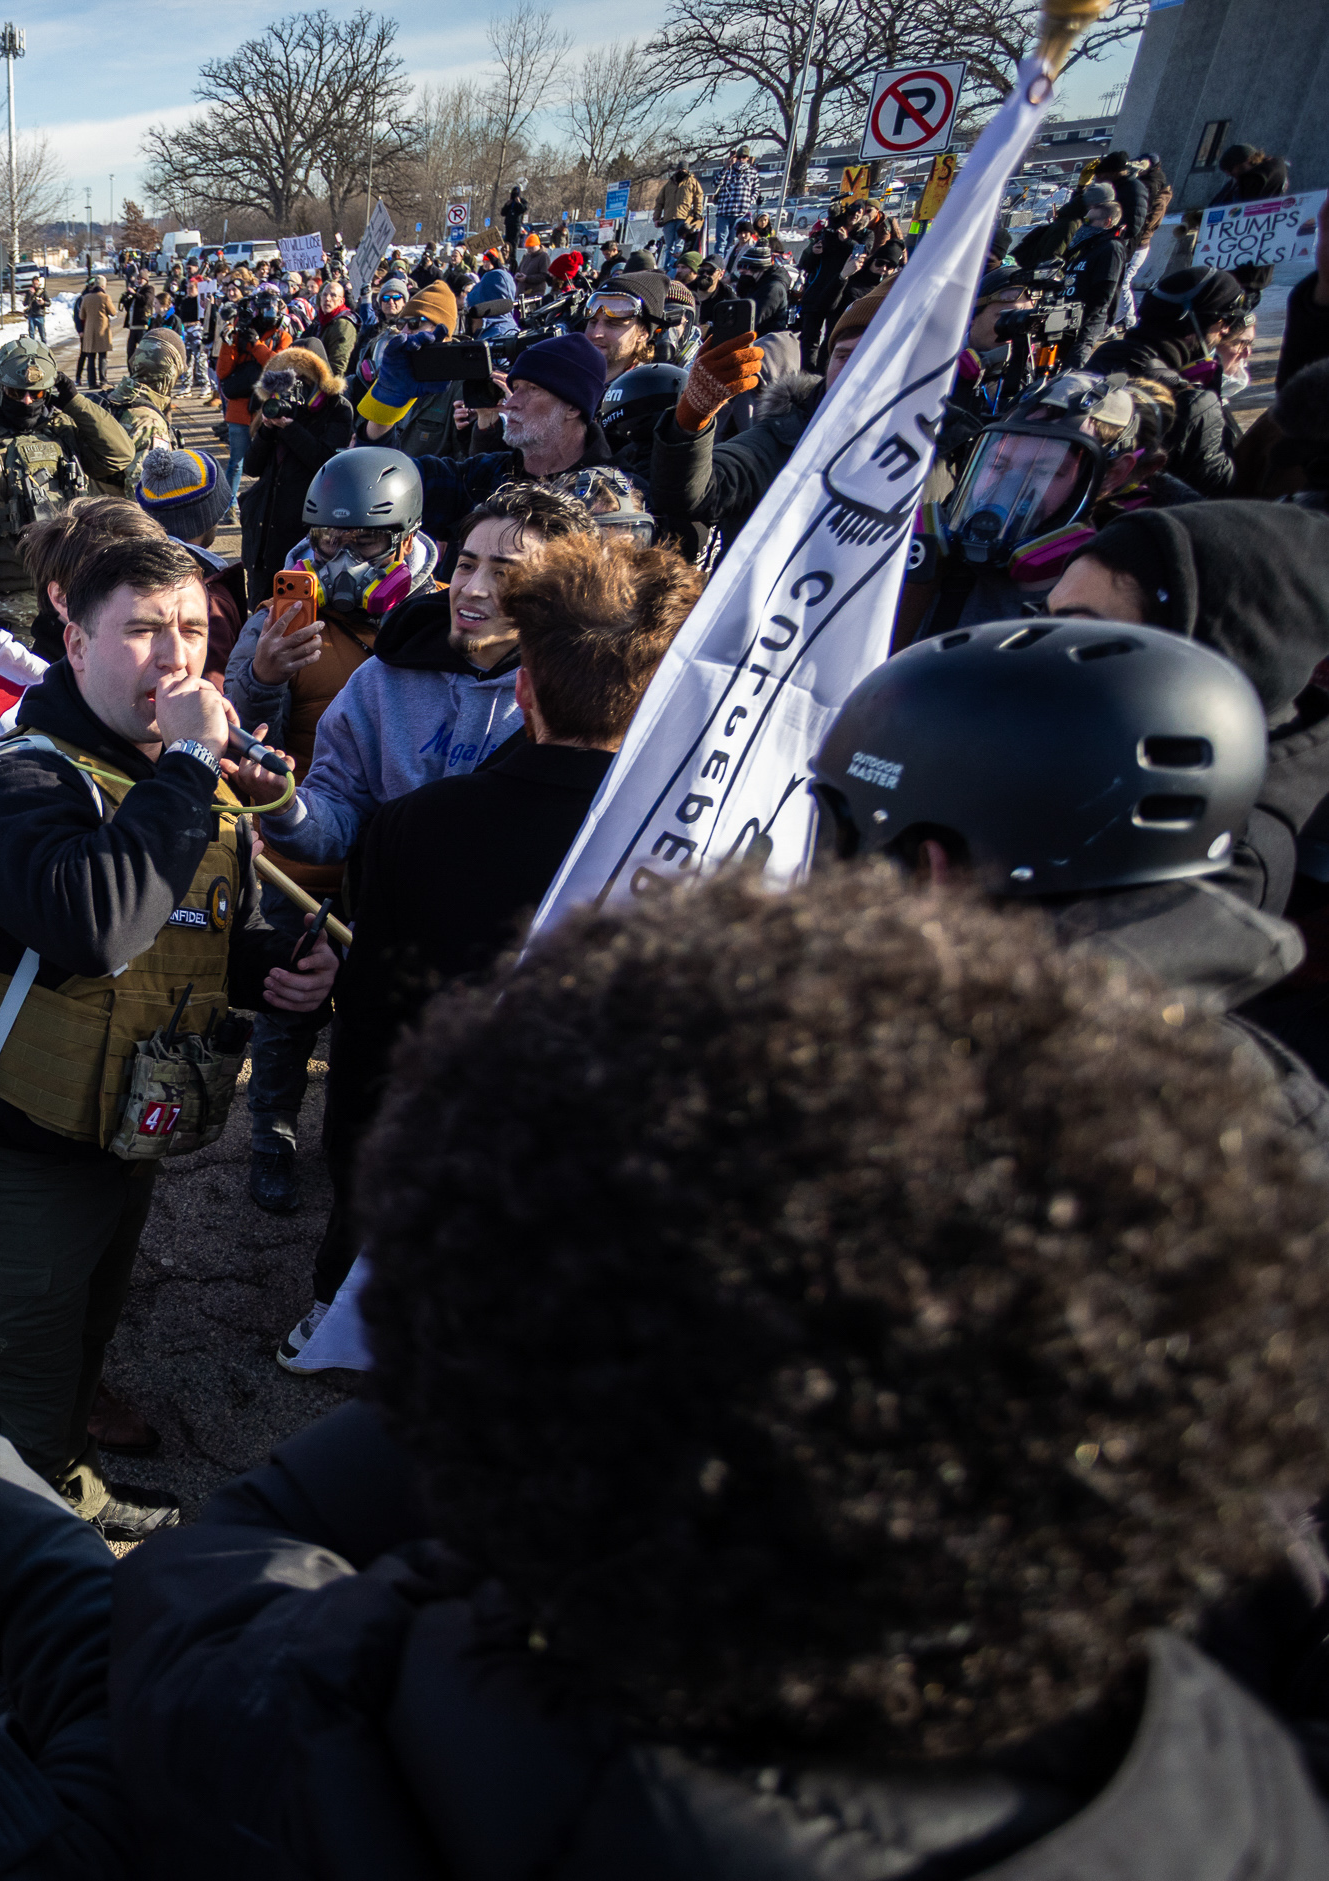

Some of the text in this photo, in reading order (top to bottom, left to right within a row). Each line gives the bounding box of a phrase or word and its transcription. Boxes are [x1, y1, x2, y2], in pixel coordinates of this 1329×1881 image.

[1206, 211, 1300, 240] TRUMPS
[291, 238, 305, 251] WILL
[305, 235, 321, 250] LOSE
[1217, 231, 1275, 254] GOP
[293, 255, 318, 270] FORGIVE
[1203, 243, 1296, 271] SUCKS!
[604, 388, 623, 402] ern
[602, 409, 624, 428] SMITH
[846, 762, 900, 789] MASTER
[852, 752, 905, 776] OUTDOOR
